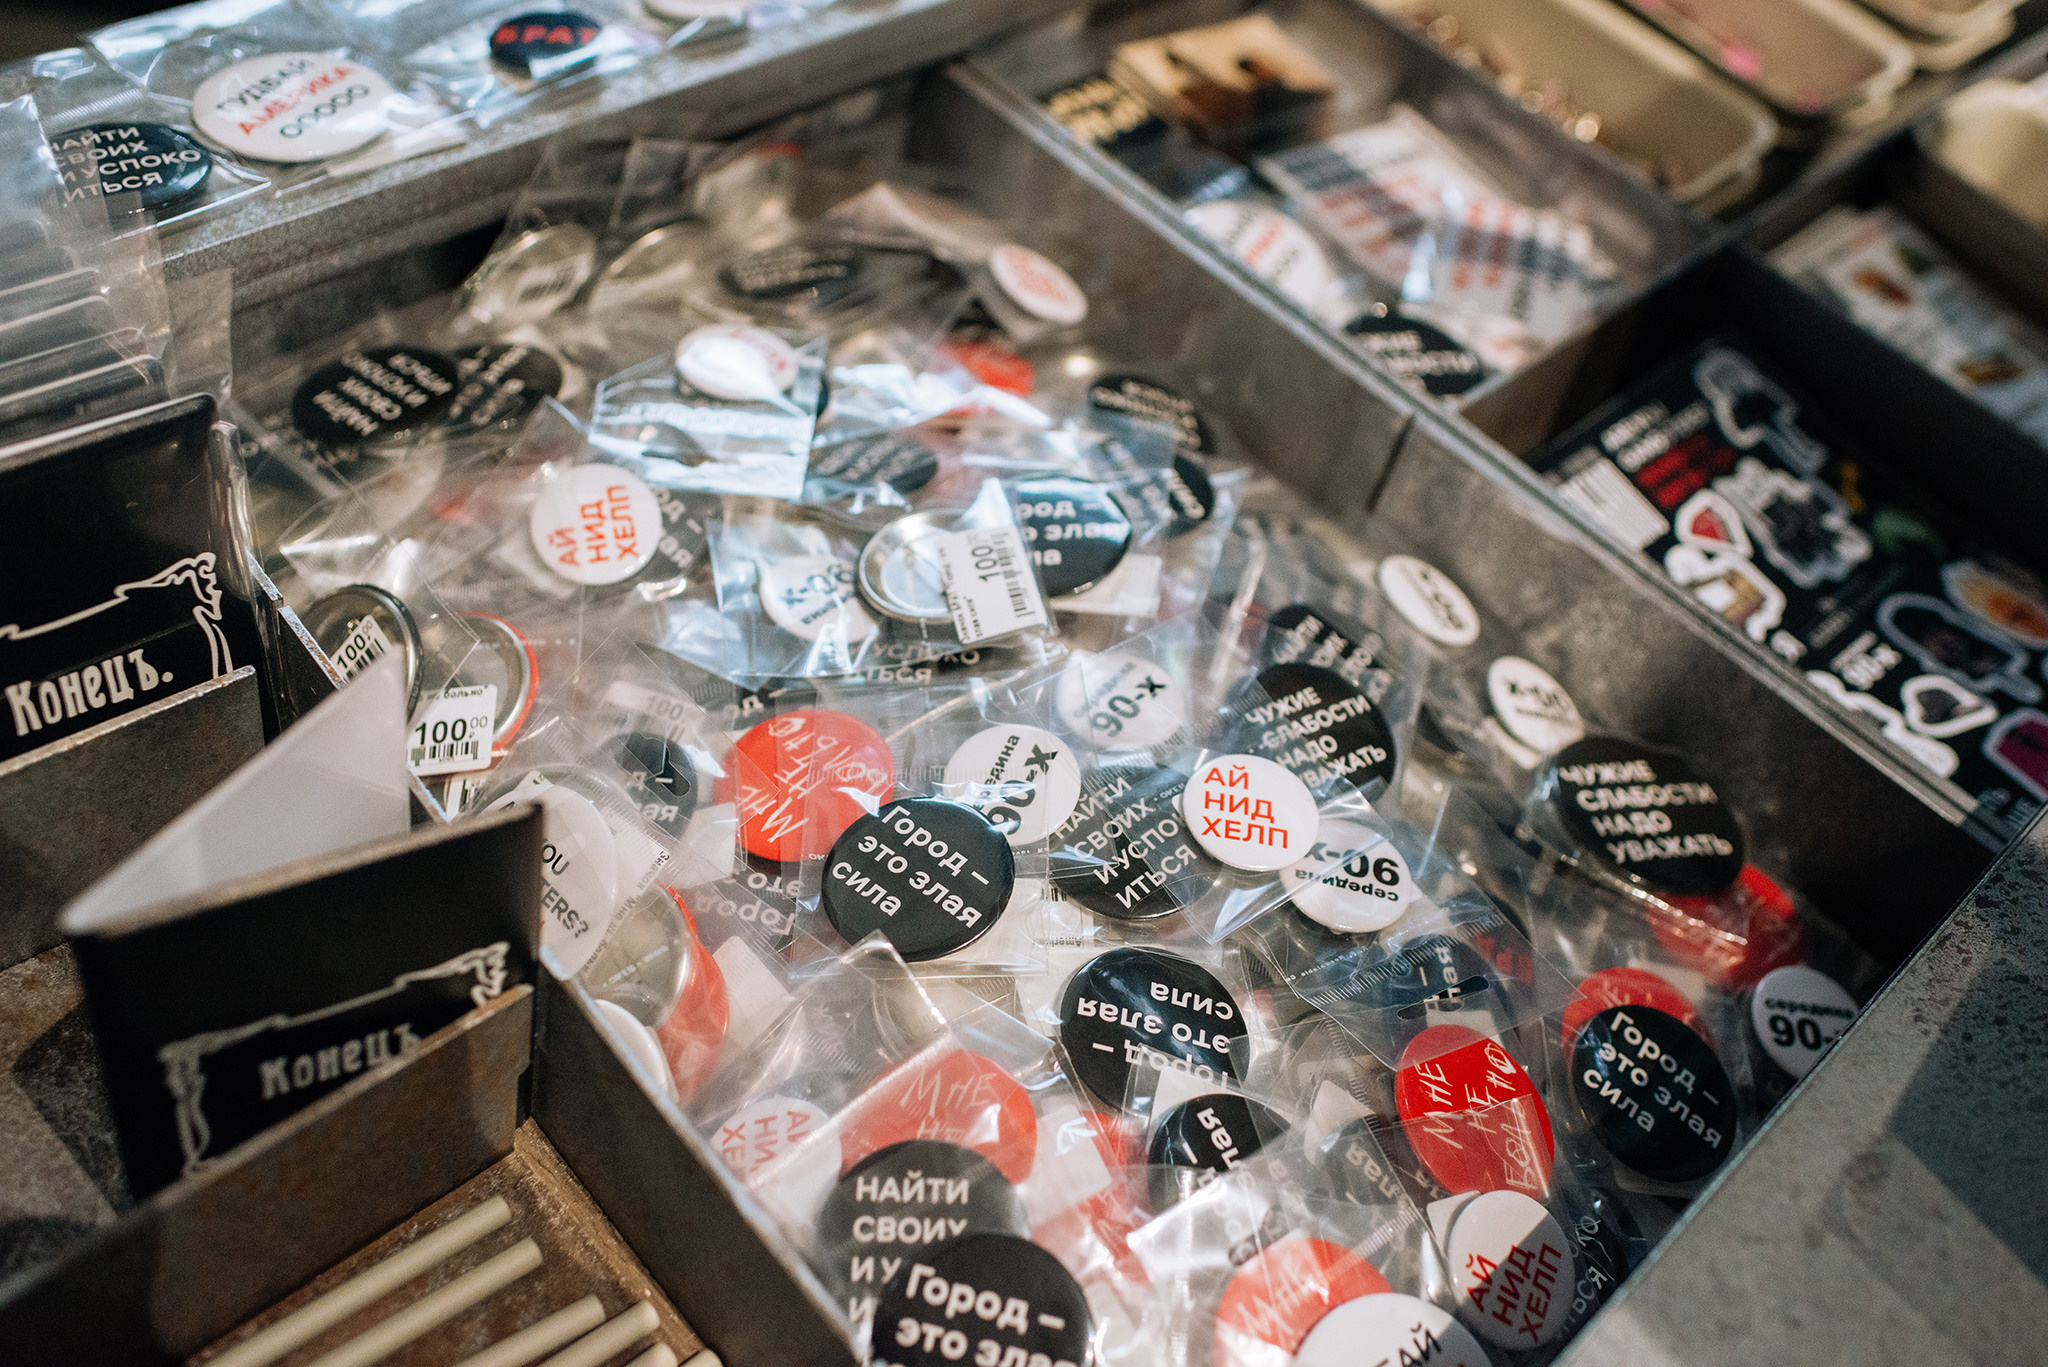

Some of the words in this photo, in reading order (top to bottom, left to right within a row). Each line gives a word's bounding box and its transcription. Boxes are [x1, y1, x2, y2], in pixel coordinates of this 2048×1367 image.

[579, 499, 610, 565] НИД
[606, 484, 640, 561] ХЕЛП
[547, 526, 581, 568] АЙ
[971, 545, 999, 583] 100
[336, 633, 367, 671] 100
[1091, 674, 1166, 738] 90-х
[1244, 686, 1322, 726] ЧУЖИЕ
[1262, 694, 1372, 750] СЛАБОСТИ
[414, 718, 468, 746] 100
[1275, 734, 1338, 770] НАДО
[1203, 763, 1250, 791] АЙ
[1300, 744, 1388, 790] ВАЖАТЬ
[1072, 798, 1155, 859] СВОИХ
[1203, 790, 1276, 824] НИД
[880, 805, 968, 879] Город
[1201, 815, 1289, 849] ХЕЛП
[541, 840, 570, 876] OU
[1115, 844, 1198, 910] ИТЬСЯ
[831, 862, 903, 918] сила
[857, 833, 909, 875] это
[908, 870, 983, 930] злая
[1076, 997, 1164, 1035] злая
[1149, 981, 1234, 1021] сила
[1171, 1022, 1231, 1054] это
[1609, 1011, 1697, 1095] Город
[1769, 1014, 1840, 1051] 90-
[1583, 1069, 1657, 1133] сила
[1599, 1042, 1649, 1087] это
[1654, 1085, 1723, 1149] злая
[855, 1169, 970, 1205] НАЙТИ
[905, 1262, 1030, 1337] Город
[1465, 1252, 1498, 1313] АЙ
[1491, 1243, 1537, 1326] НИД
[1518, 1242, 1563, 1344] ХЕЛП
[895, 1316, 969, 1361] это
